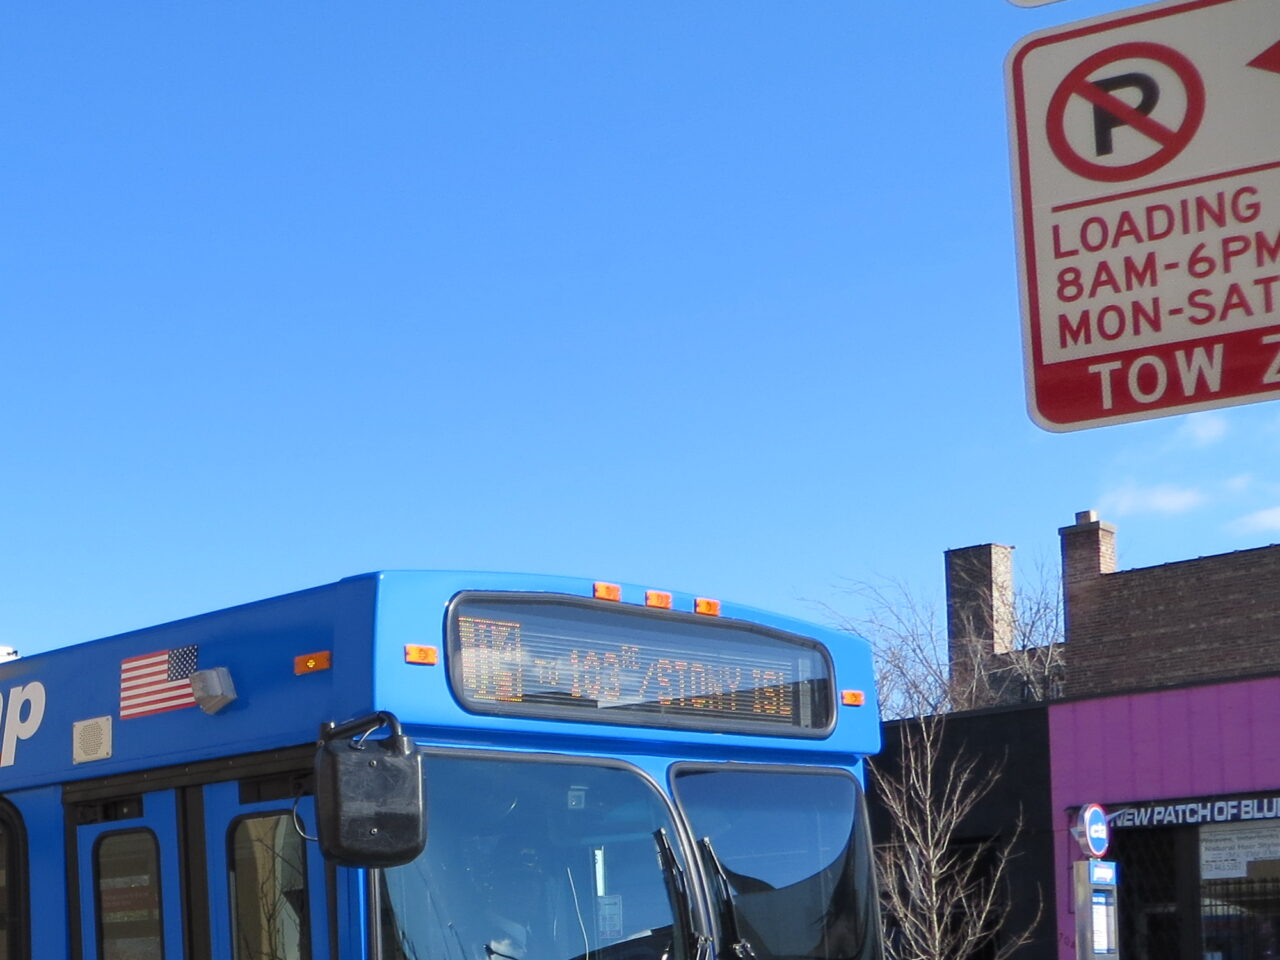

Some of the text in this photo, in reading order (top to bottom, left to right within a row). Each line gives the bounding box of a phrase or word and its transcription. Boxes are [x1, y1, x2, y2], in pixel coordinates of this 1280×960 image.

[1051, 185, 1262, 259] LOADING
[1057, 274, 1280, 349] MON-SAT
[1087, 342, 1225, 411] TOW
[1153, 802, 1212, 825] PATCH
[1214, 801, 1238, 822] OF
